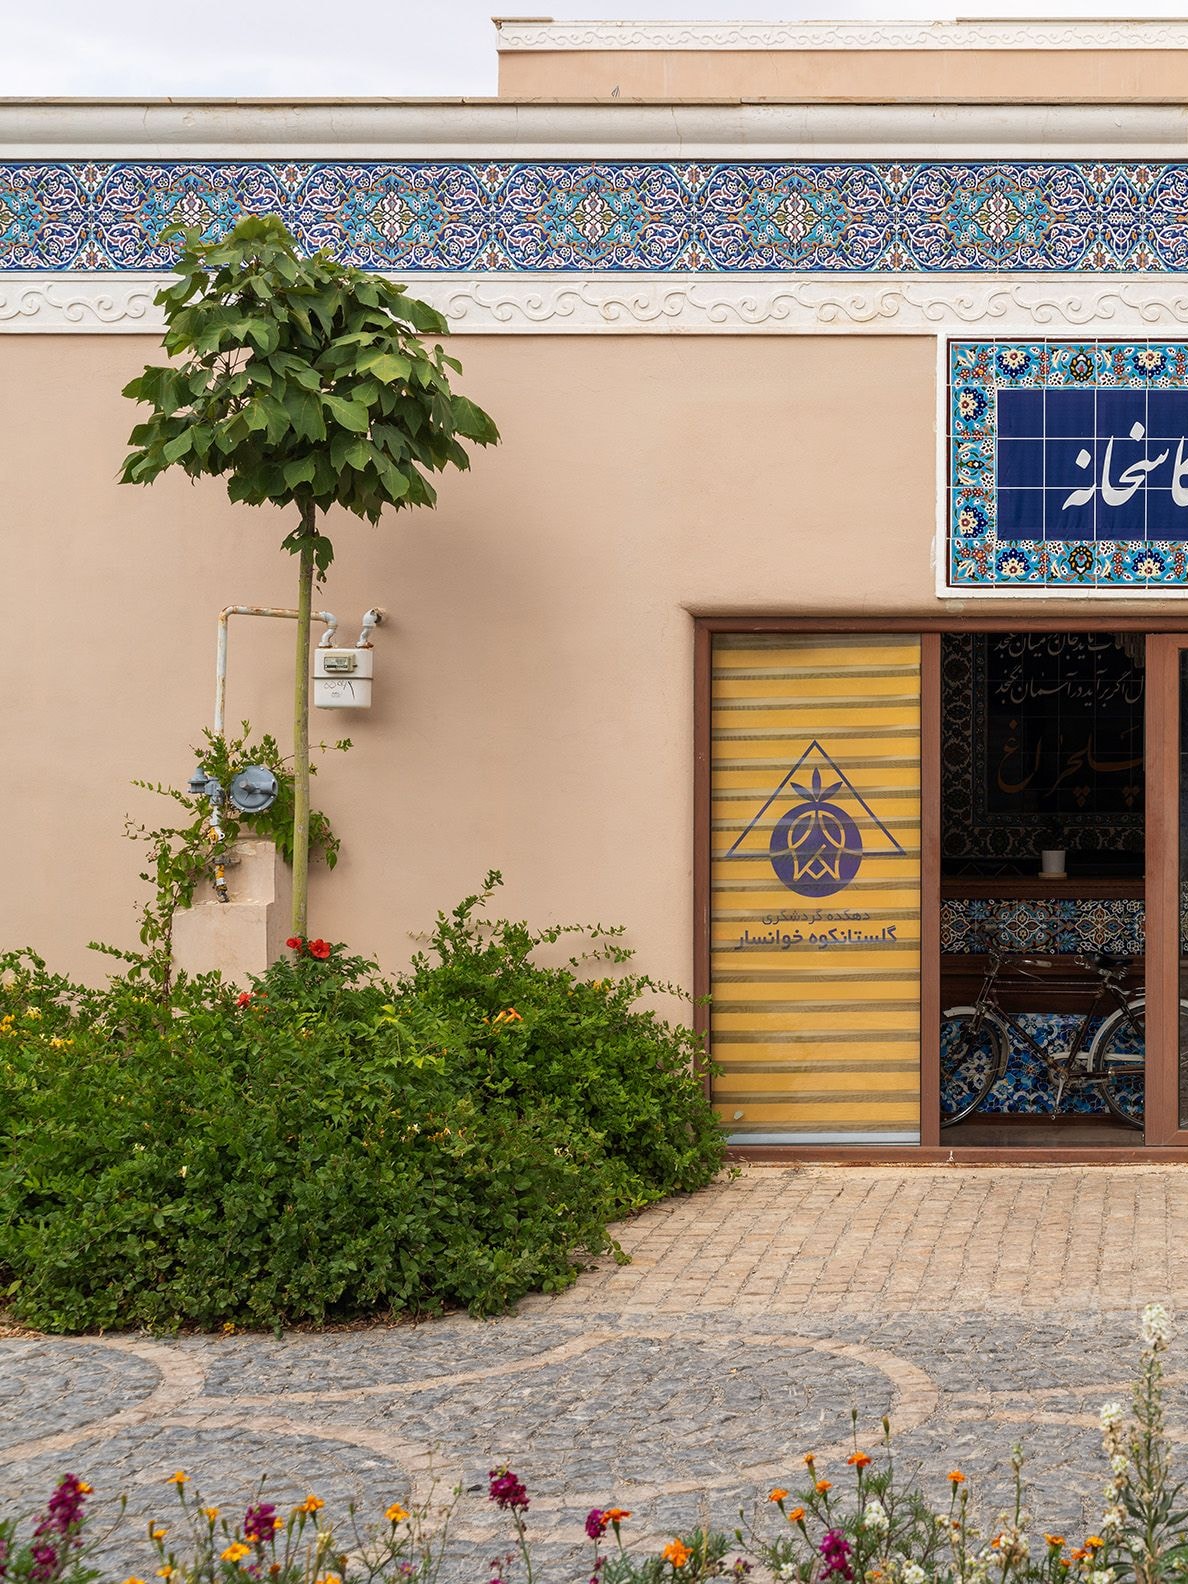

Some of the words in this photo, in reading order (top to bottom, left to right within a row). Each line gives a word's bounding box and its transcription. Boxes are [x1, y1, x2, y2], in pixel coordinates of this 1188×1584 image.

[826, 909, 871, 922] دهکده
[734, 929, 804, 950] خوانسار
[808, 924, 898, 950] گلستانکوه
